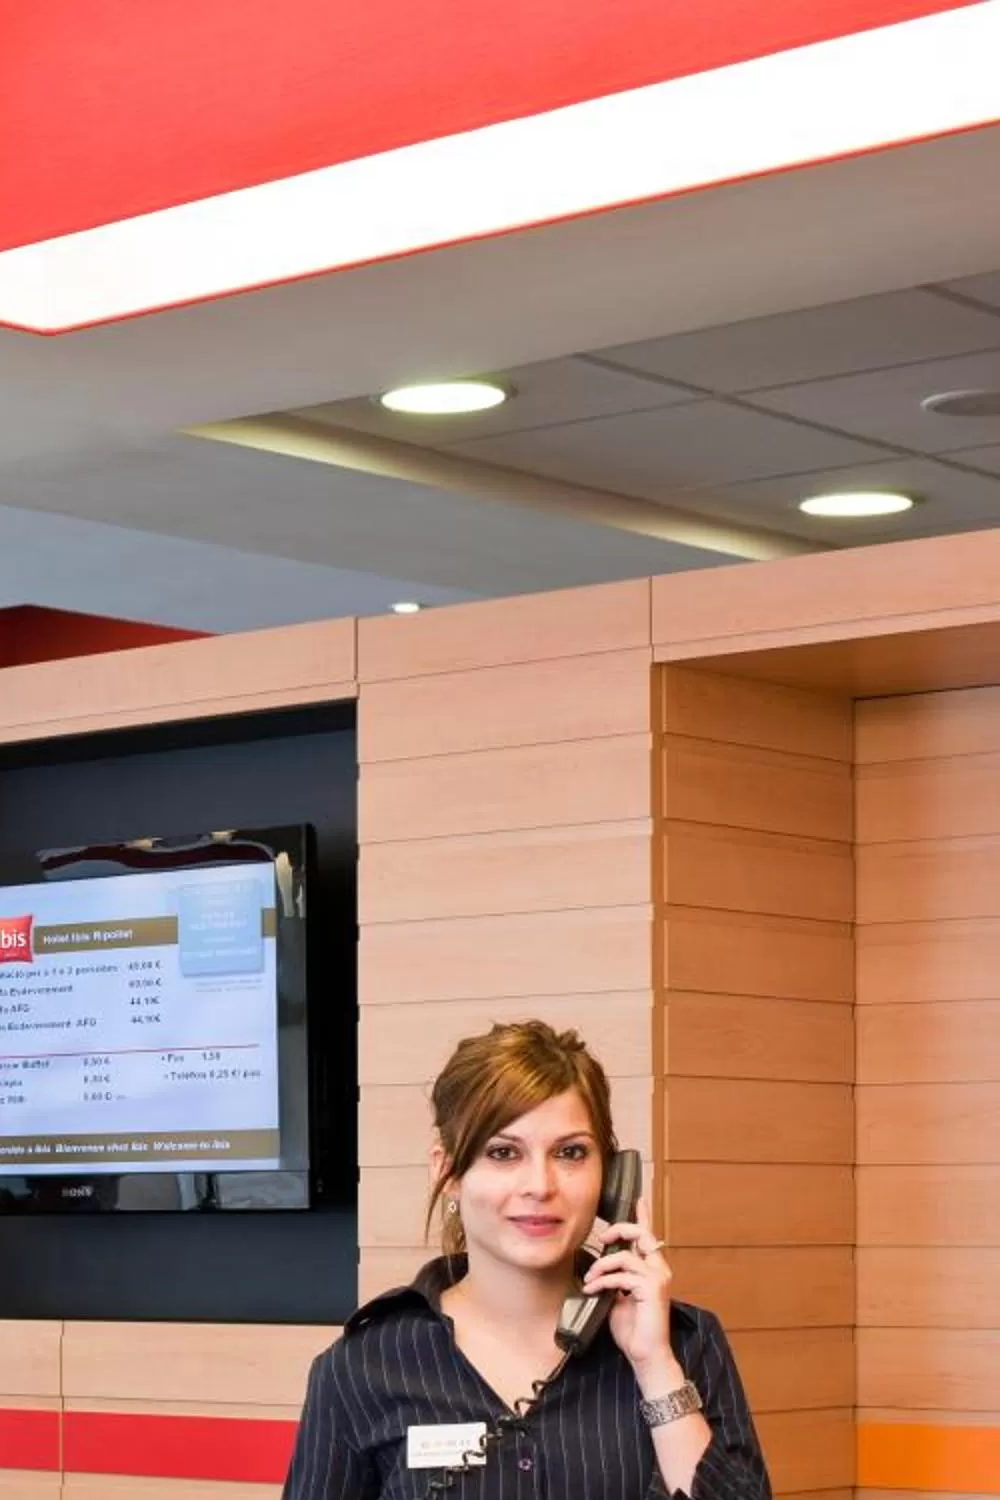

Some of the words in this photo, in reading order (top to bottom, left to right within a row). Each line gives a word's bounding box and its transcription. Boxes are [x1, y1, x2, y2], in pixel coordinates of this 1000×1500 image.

[9, 1003, 31, 1013] AF
[153, 1140, 198, 1152] Welce
[61, 1185, 94, 1197] ONY
